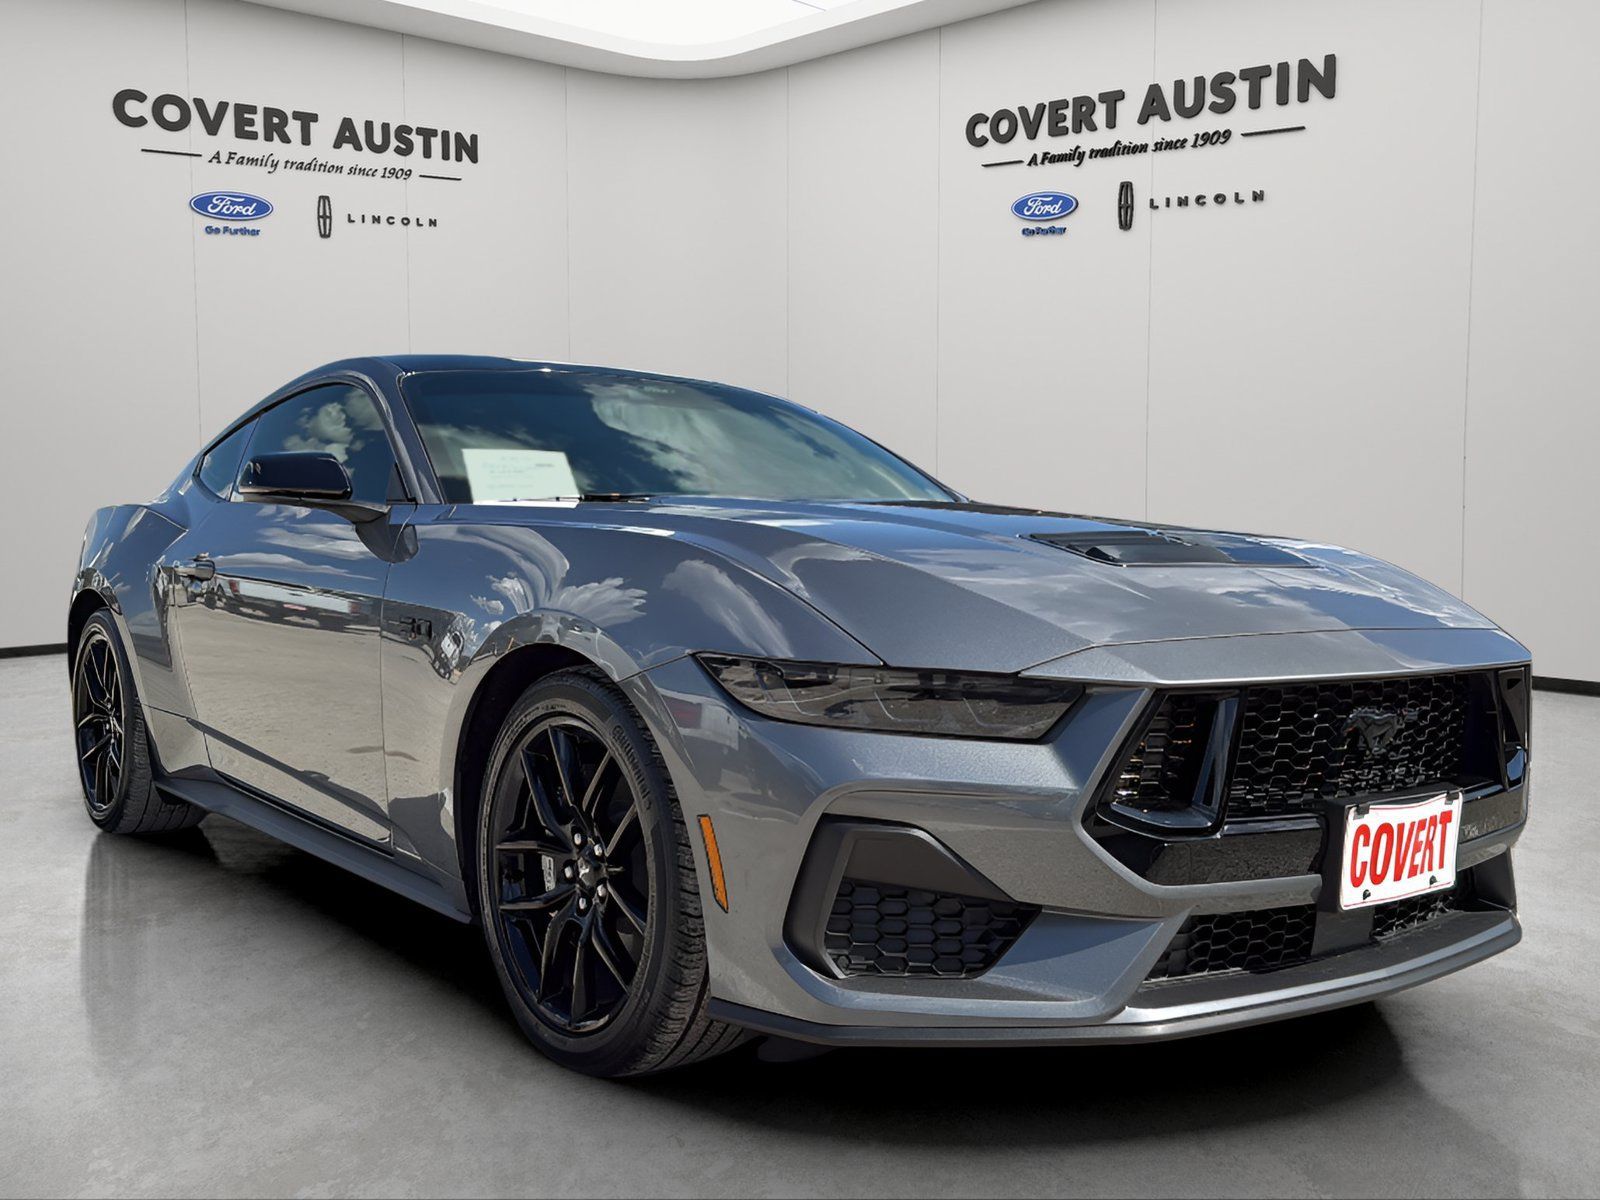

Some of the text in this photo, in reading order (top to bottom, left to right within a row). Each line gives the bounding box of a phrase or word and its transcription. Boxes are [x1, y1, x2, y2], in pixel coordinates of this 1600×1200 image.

[966, 53, 1337, 149] COVERT AUSTIN
[112, 88, 479, 165] COVERT AUSTIN
[1027, 128, 1233, 168] A Family tradition since 1909
[208, 151, 413, 181] A Family tradition since 1909
[207, 195, 257, 215] Ford
[1023, 196, 1063, 216] Ford
[1149, 189, 1265, 211] LINCOLN
[205, 225, 261, 237] Go Further
[347, 213, 438, 228] LINCOLN
[1350, 810, 1453, 888] COVERT
